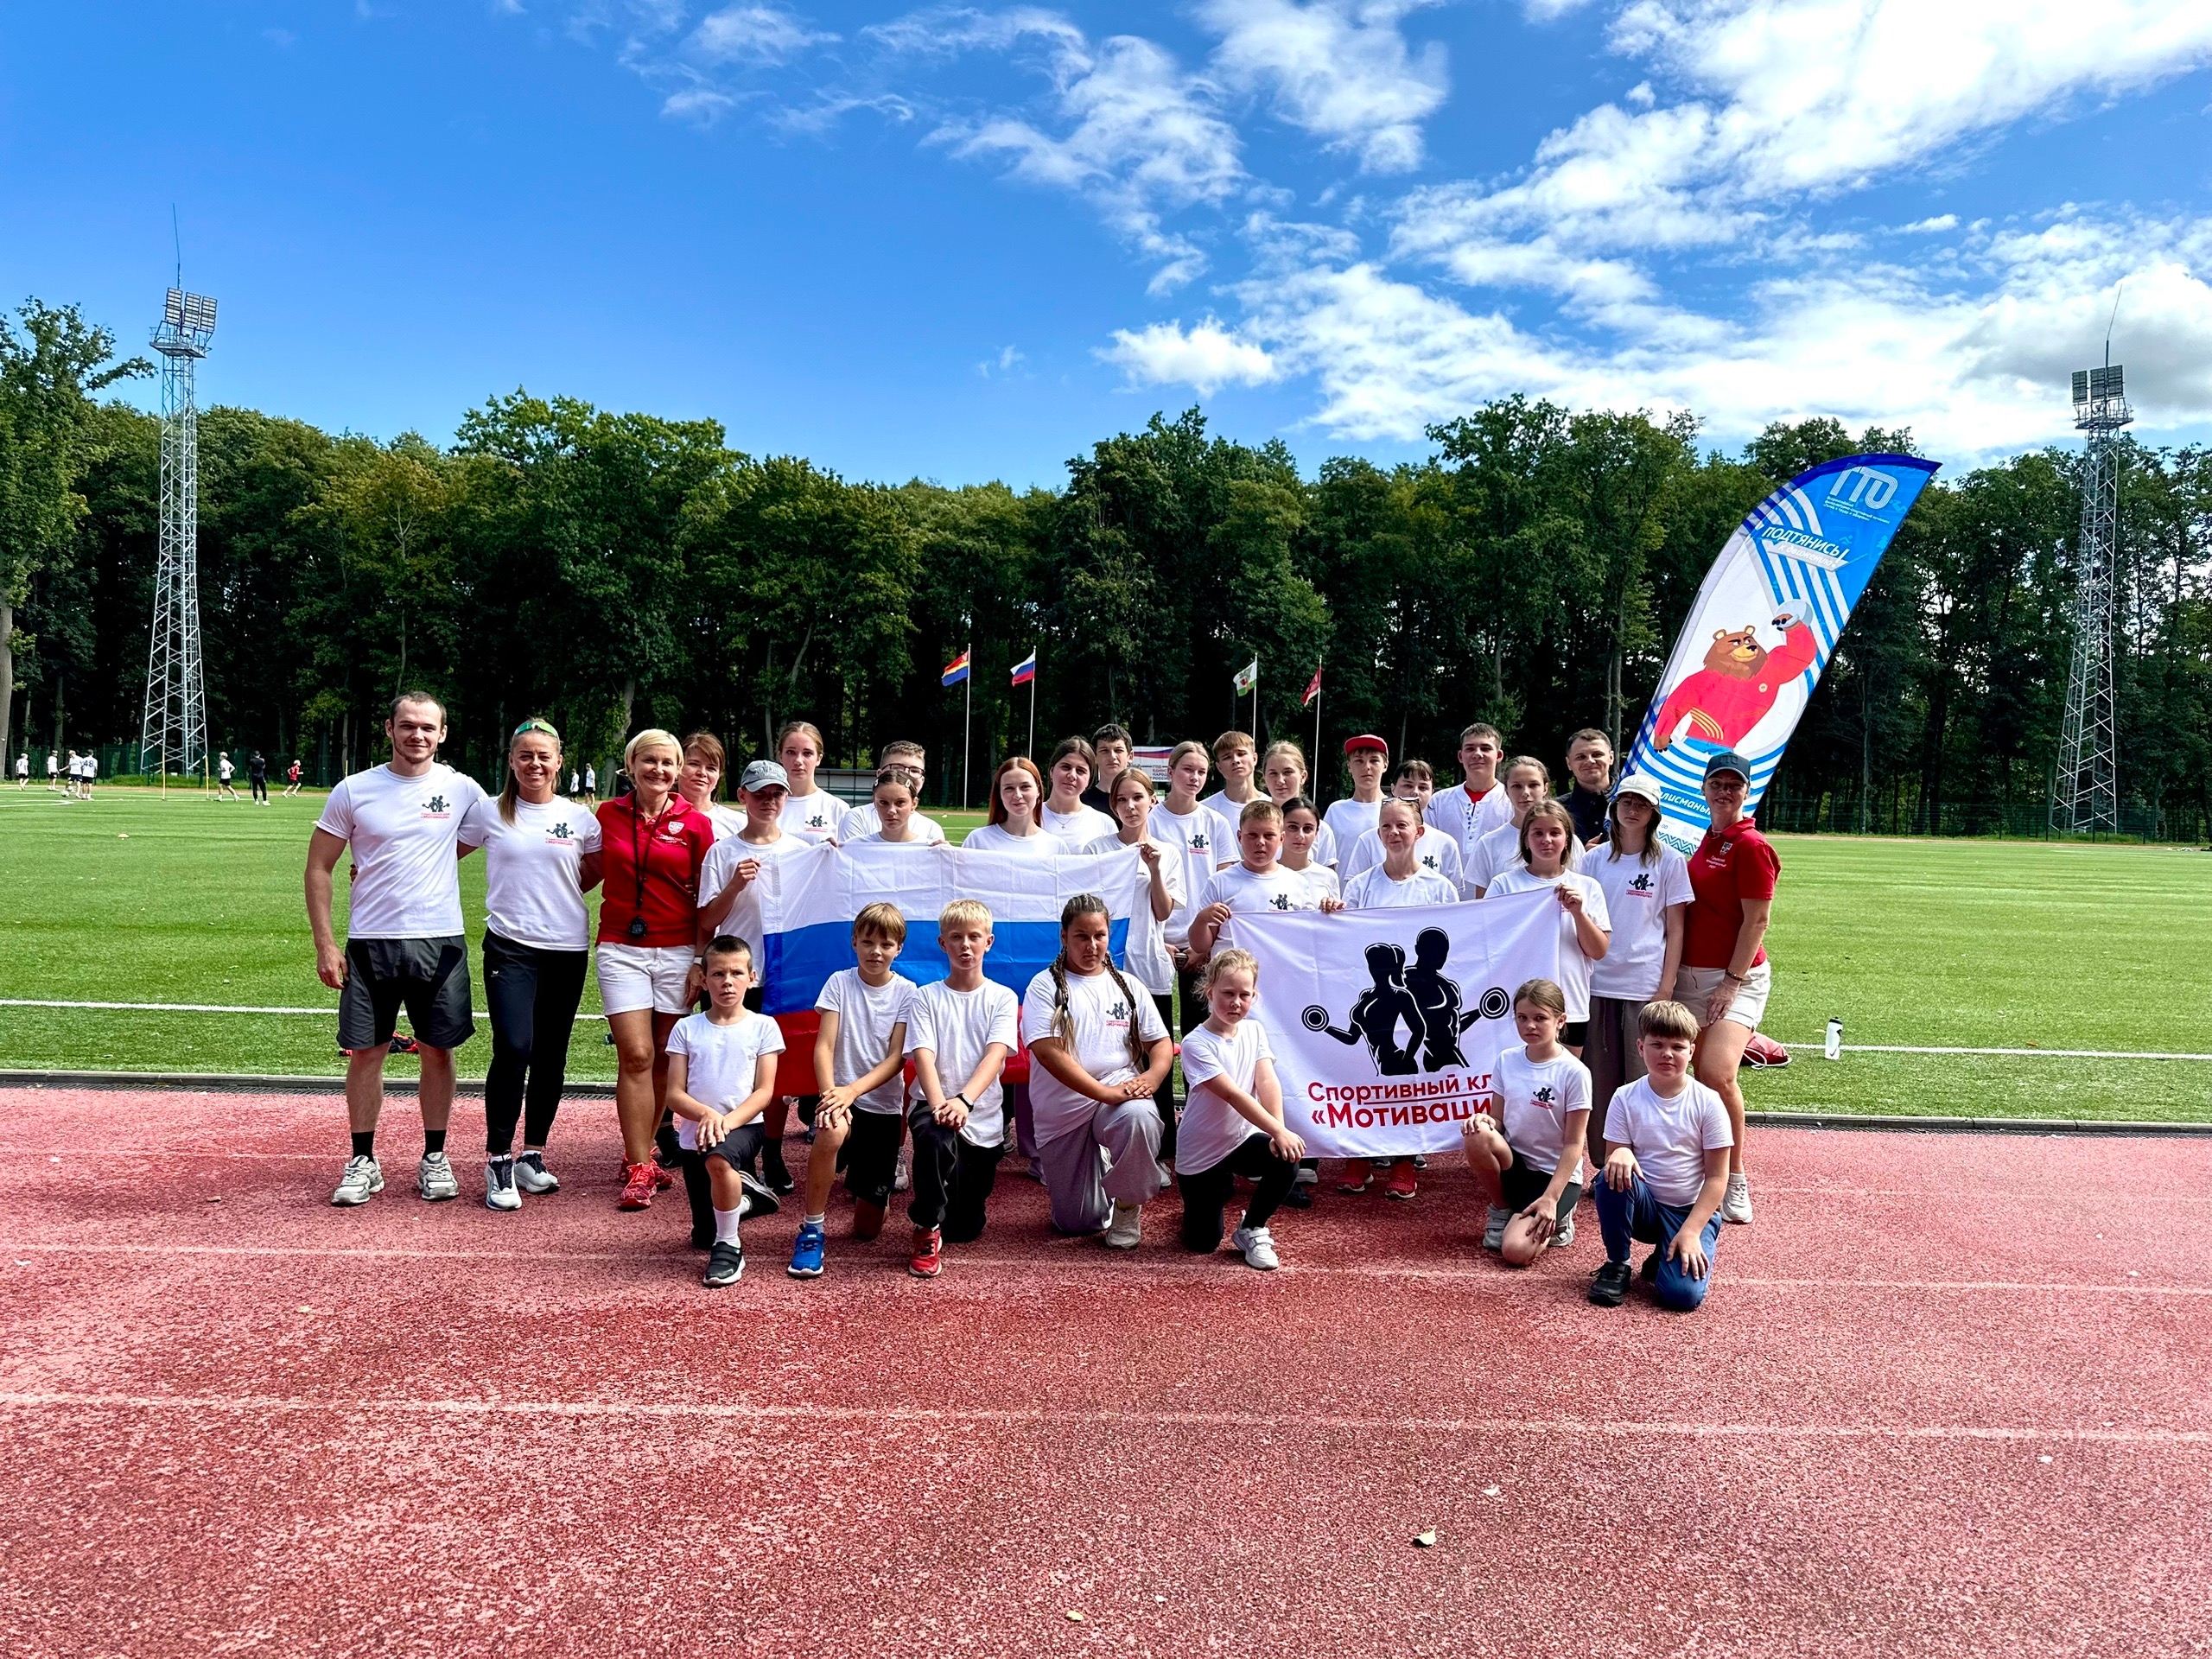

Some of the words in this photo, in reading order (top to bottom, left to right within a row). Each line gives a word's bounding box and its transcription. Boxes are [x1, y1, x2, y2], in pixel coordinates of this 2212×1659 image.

[1829, 464, 1898, 510] ГТО
[83, 760, 94, 768] 48
[1307, 1074, 1460, 1106] Спортивный
